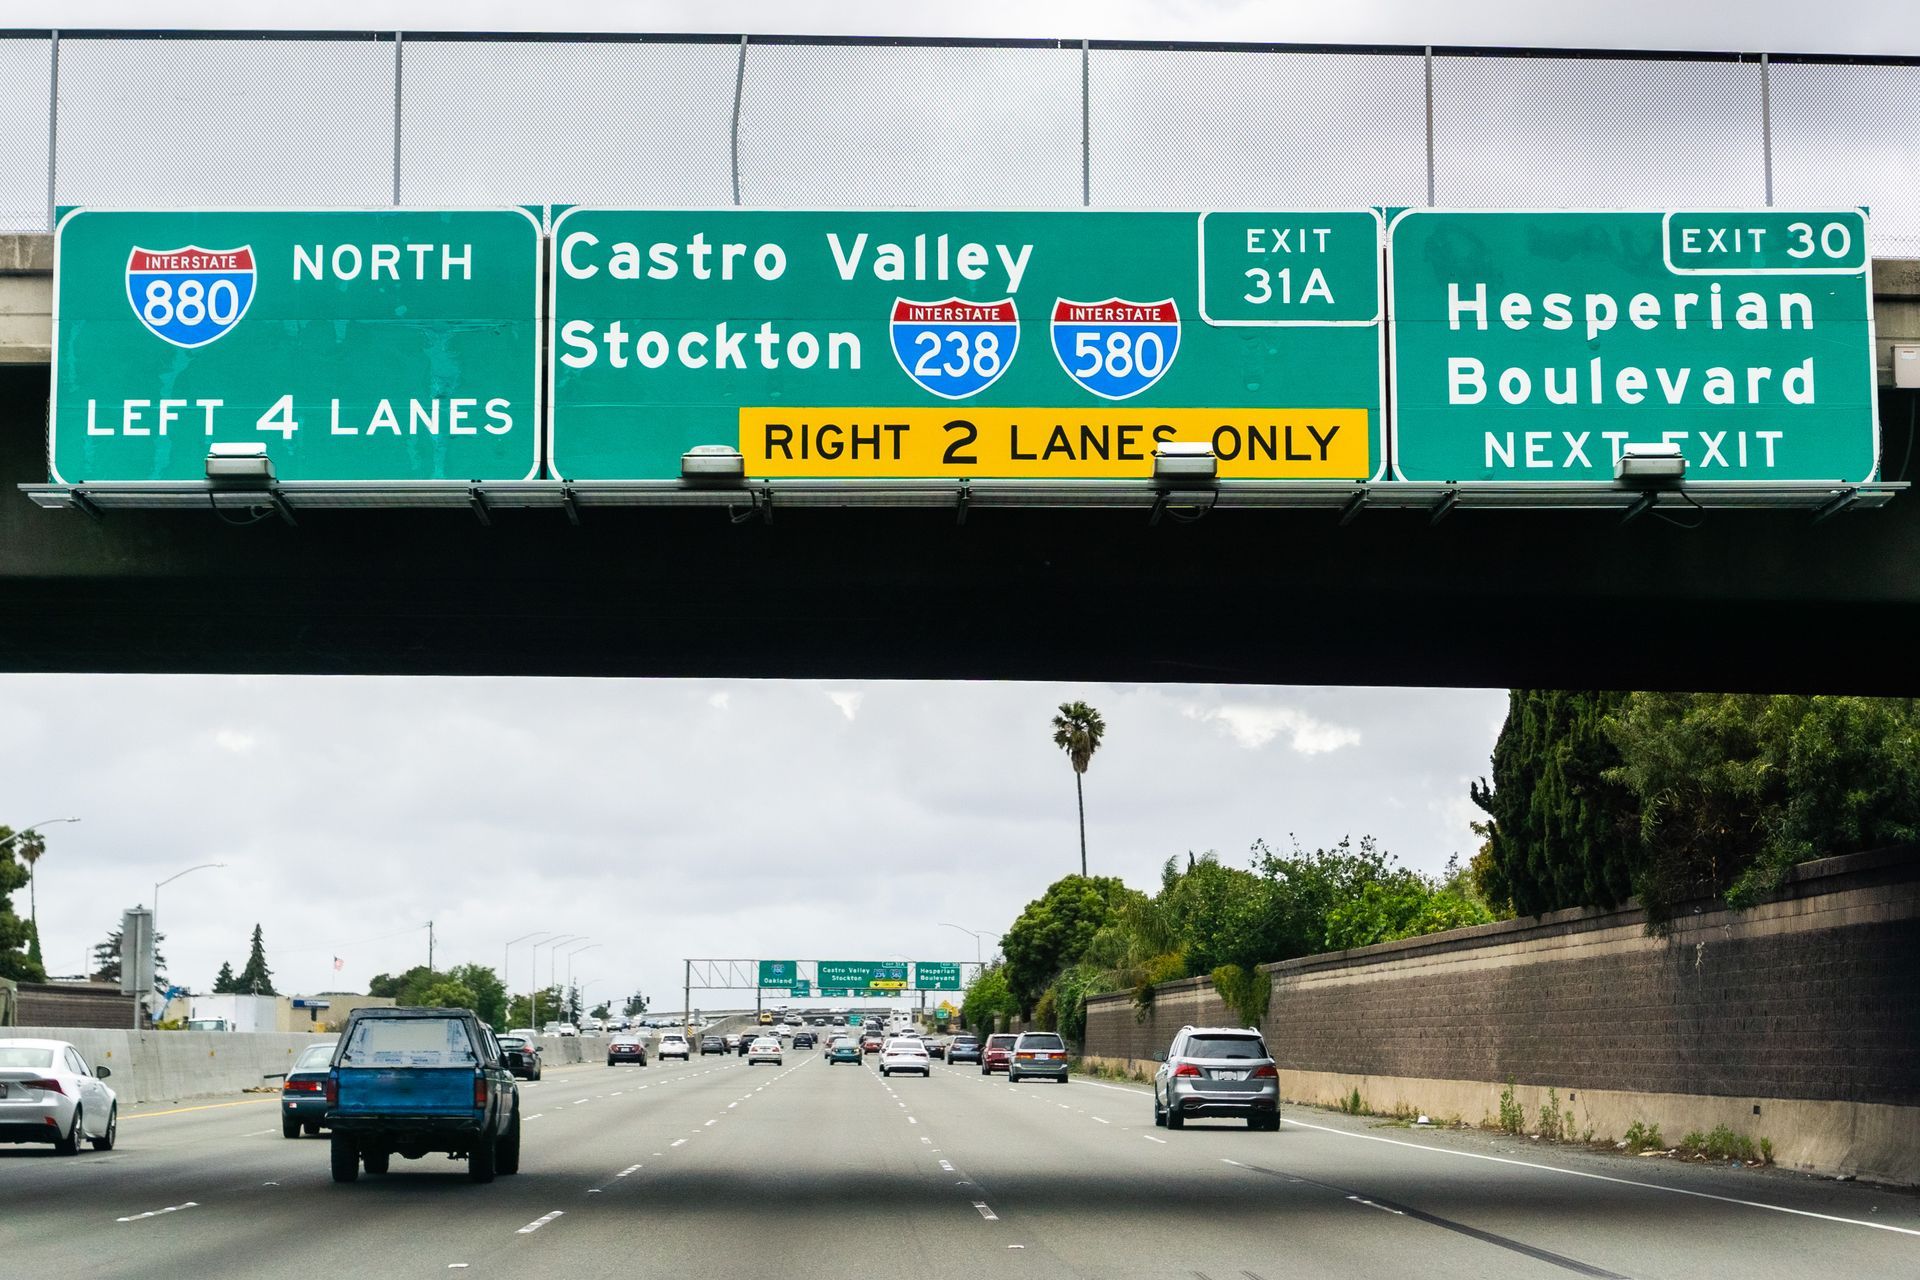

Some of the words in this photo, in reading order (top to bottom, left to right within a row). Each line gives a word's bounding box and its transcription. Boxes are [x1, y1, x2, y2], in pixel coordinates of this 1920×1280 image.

[1247, 228, 1331, 253] EXIT
[1682, 228, 1766, 253] EXIT
[1786, 222, 1851, 259] 30
[145, 255, 238, 270] INTERSTATE
[293, 244, 472, 281] NORTH
[561, 231, 787, 281] Castro
[826, 233, 1034, 293] Valley
[143, 279, 240, 327] 880
[1244, 267, 1335, 304] 31A
[908, 308, 1001, 321] INTERSTATE
[1070, 308, 1161, 321] INTERSTATE
[1448, 282, 1814, 341] Hesperian
[560, 319, 861, 369] Stockton
[914, 331, 1001, 378] 238
[1074, 331, 1164, 378] 580
[1448, 356, 1815, 405] Boulevard
[87, 399, 224, 436] LEFT
[256, 394, 299, 440] 4
[331, 398, 513, 435] LANES
[765, 424, 910, 460] RIGHT
[942, 420, 978, 465] 2
[1211, 425, 1340, 461] ONLY
[1485, 431, 1629, 468] NEXT
[848, 967, 870, 975] Valley
